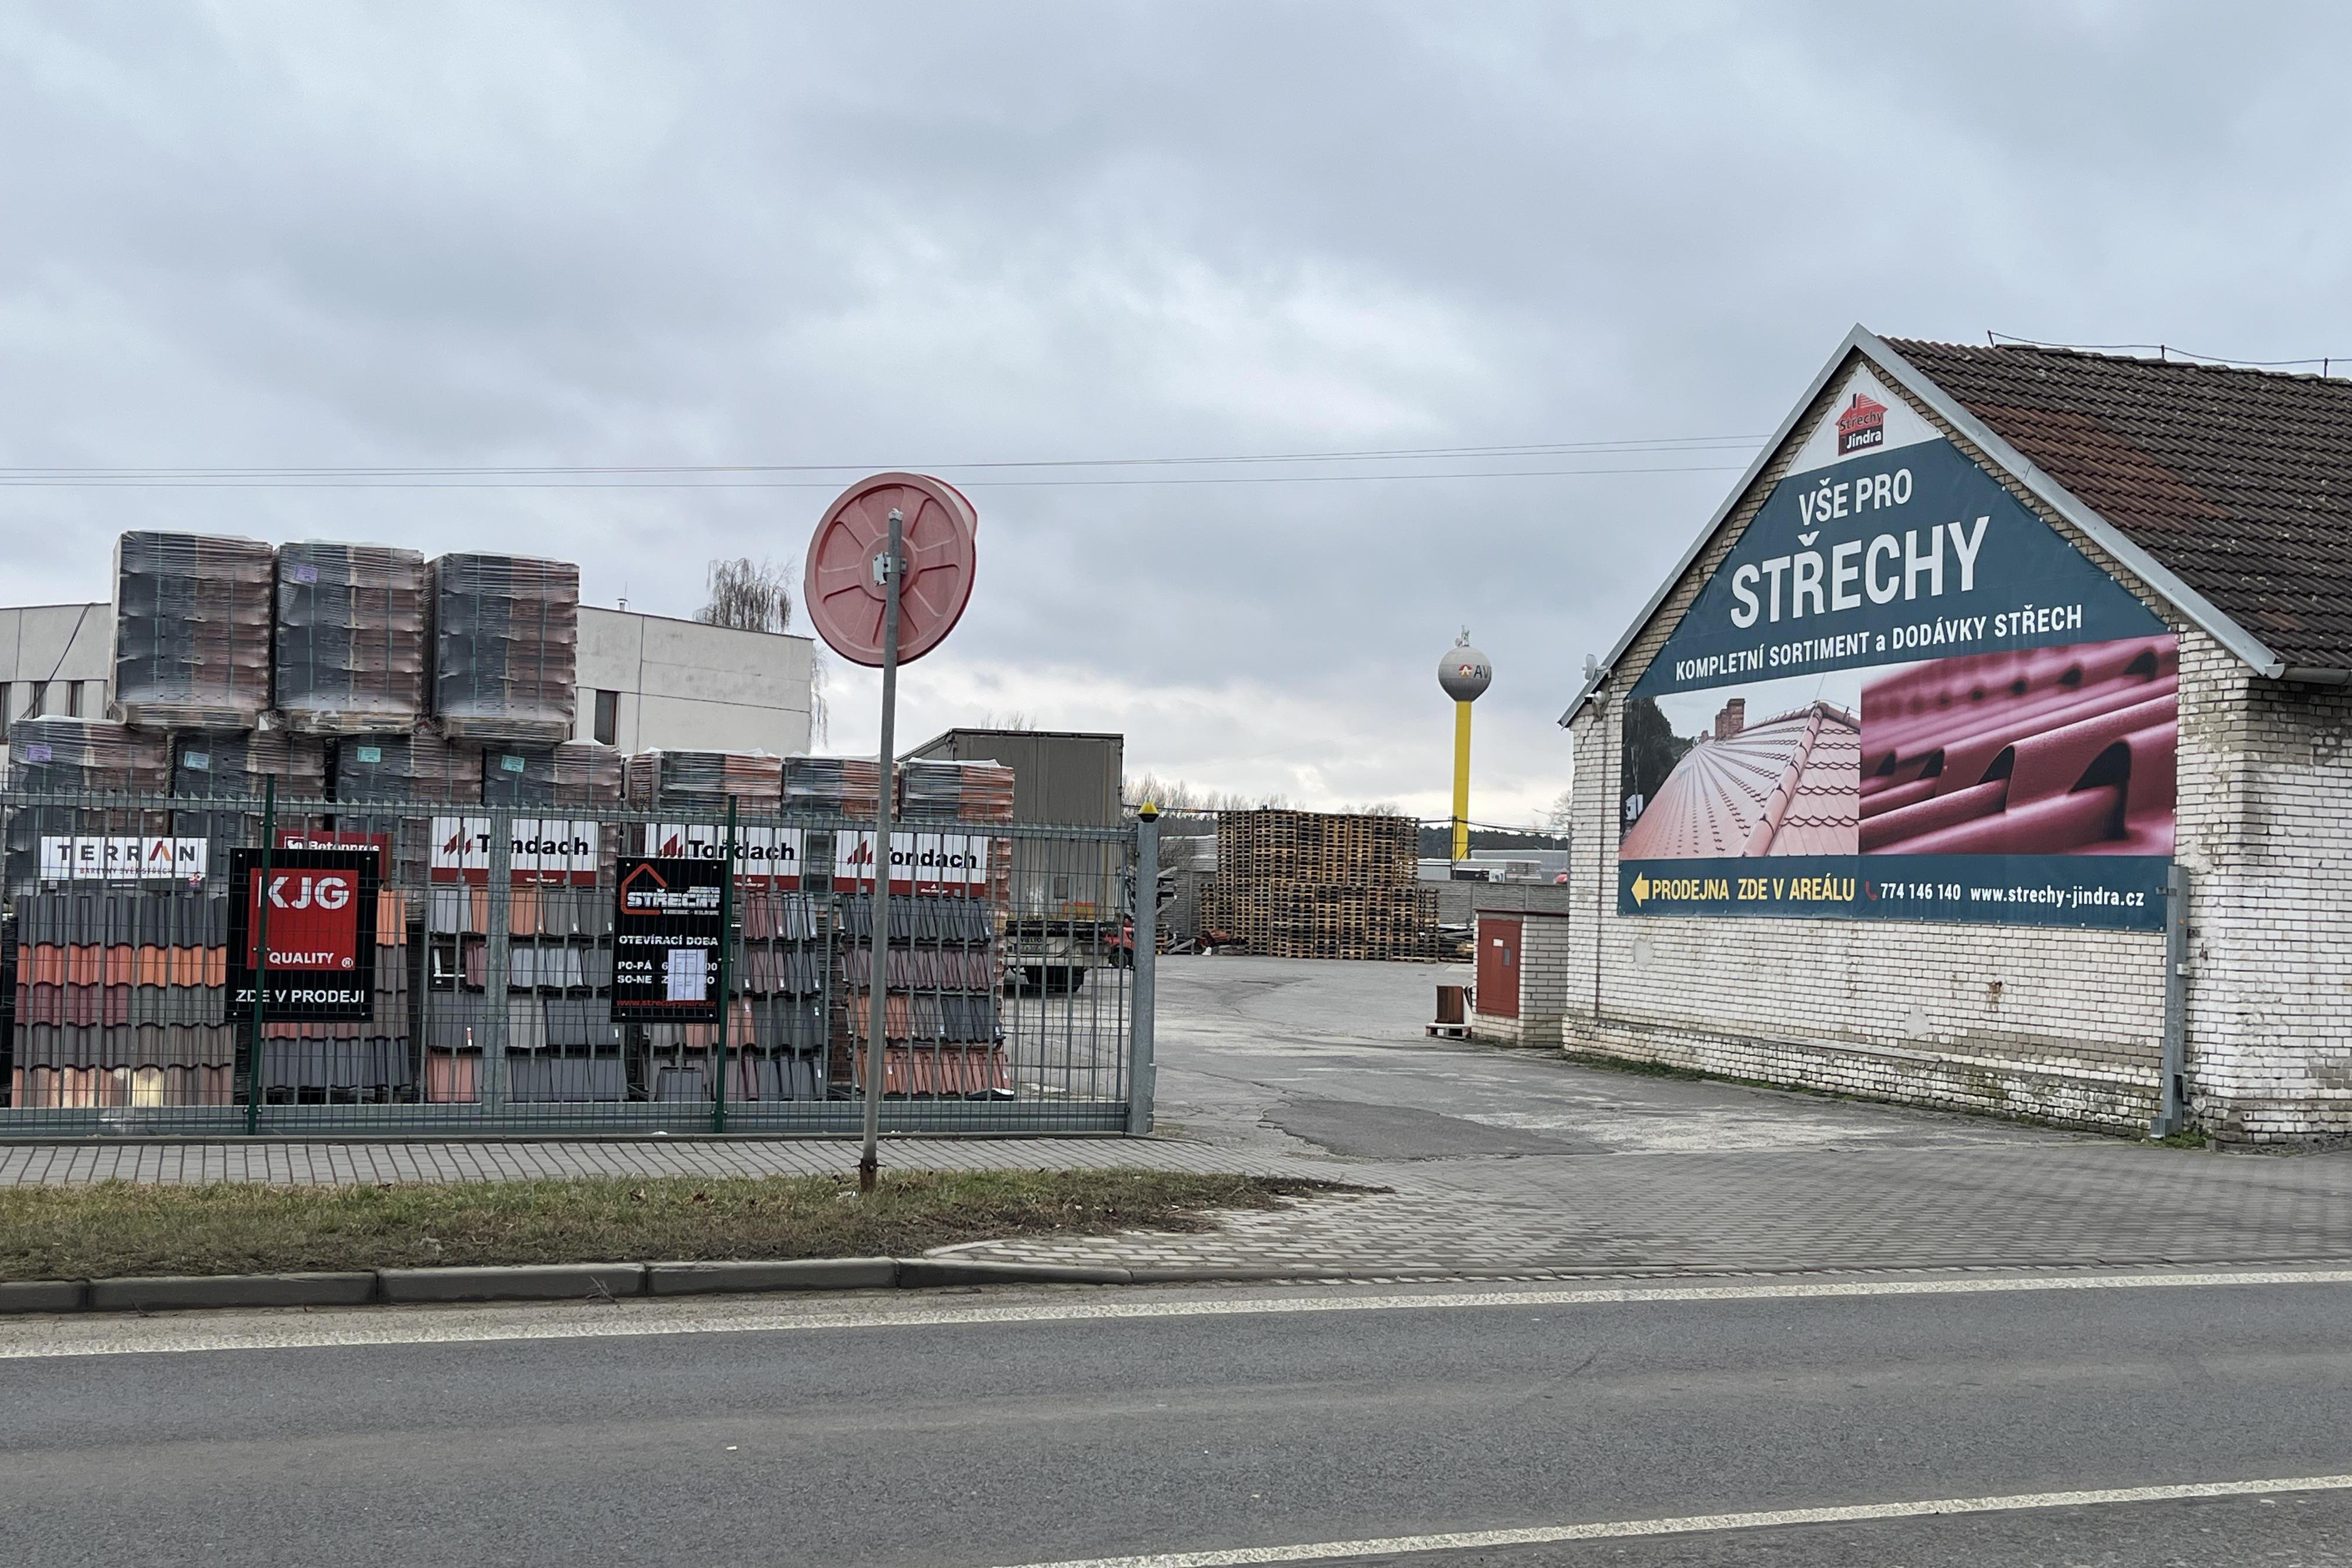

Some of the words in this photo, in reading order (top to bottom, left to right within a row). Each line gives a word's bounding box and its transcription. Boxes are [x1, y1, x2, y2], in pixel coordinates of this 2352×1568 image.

[1846, 430, 1882, 449] Jindra
[1799, 477, 1849, 526] VŠE
[1856, 469, 1912, 513] PRO
[1730, 516, 1990, 629] STŘECHY
[1676, 643, 1765, 681] KOMPLETNÍ
[1769, 631, 1870, 667] SORTIMENT
[1876, 634, 1886, 652] a
[1892, 616, 1987, 650] DODÁVKY
[1994, 604, 2083, 638] STŘECH
[58, 840, 195, 861] TERRAN
[258, 876, 350, 910] KJG
[1652, 879, 1730, 901] PRODEJNA
[1738, 878, 1768, 901] ZDE
[1772, 878, 1785, 900] V
[1789, 872, 1855, 901] AREÁLU
[1880, 882, 1904, 900] 774
[1909, 883, 1933, 900] 146
[1937, 884, 1961, 901] 140
[1970, 884, 2145, 908] www.strechy-jindra.cz
[619, 934, 683, 945] OTEVÍRACÍ
[686, 937, 719, 945] DOBA
[269, 952, 334, 964] QUALITY
[618, 960, 653, 970] PO-PÁ
[617, 975, 653, 984] SO-NE
[236, 989, 270, 1002] ZDE
[275, 989, 287, 1002] V
[291, 989, 365, 1003] PRODEJI
